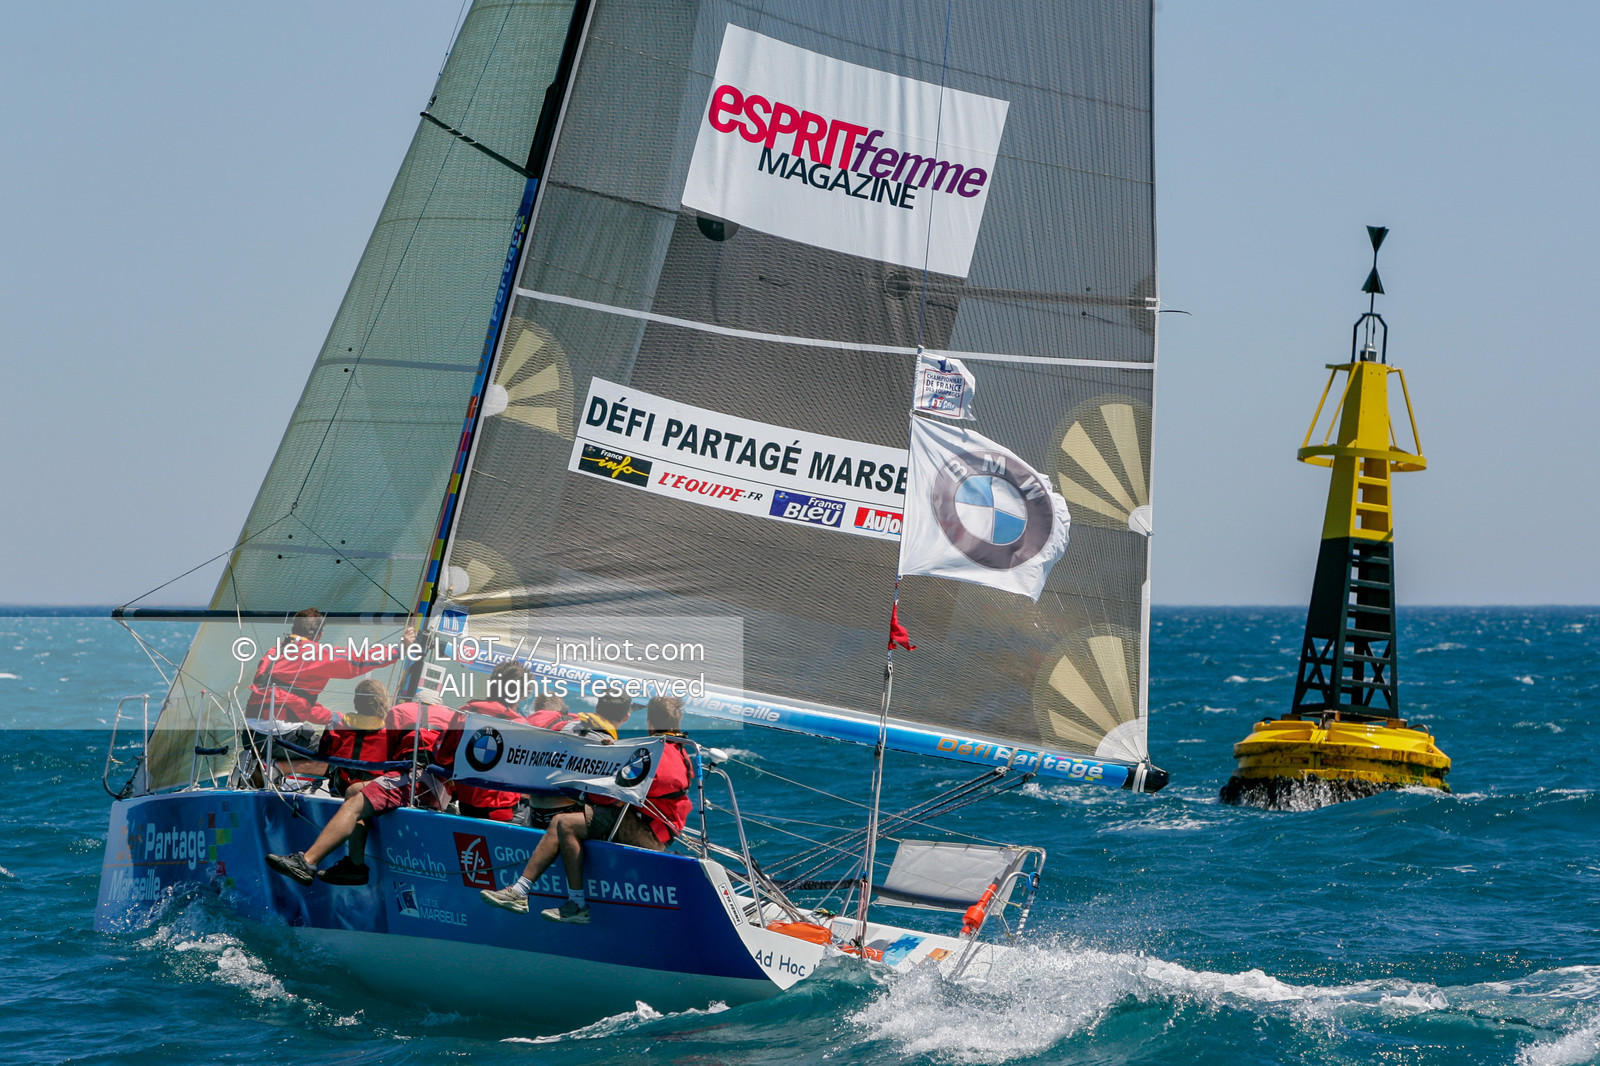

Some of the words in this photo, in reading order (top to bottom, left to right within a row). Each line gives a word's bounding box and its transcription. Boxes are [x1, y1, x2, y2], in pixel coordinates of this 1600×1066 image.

[758, 147, 918, 210] MAGAZINE
[926, 379, 934, 387] DE
[937, 382, 962, 392] FRANCE
[585, 396, 656, 442] DÉFI
[661, 418, 803, 476] PARTAGÉ
[597, 455, 636, 479] info
[600, 450, 624, 461] France
[943, 454, 1046, 501] BMW
[808, 497, 843, 511] France
[864, 509, 902, 536] Aujo
[686, 694, 781, 722] Marseille
[474, 726, 503, 746] BMW
[936, 737, 992, 759] Défi
[507, 744, 528, 766] DÉFI
[529, 750, 567, 769] PARTAGÉ
[565, 756, 621, 777] MARSEILLE
[755, 949, 774, 968] Ad
[779, 955, 806, 977] Hoc
